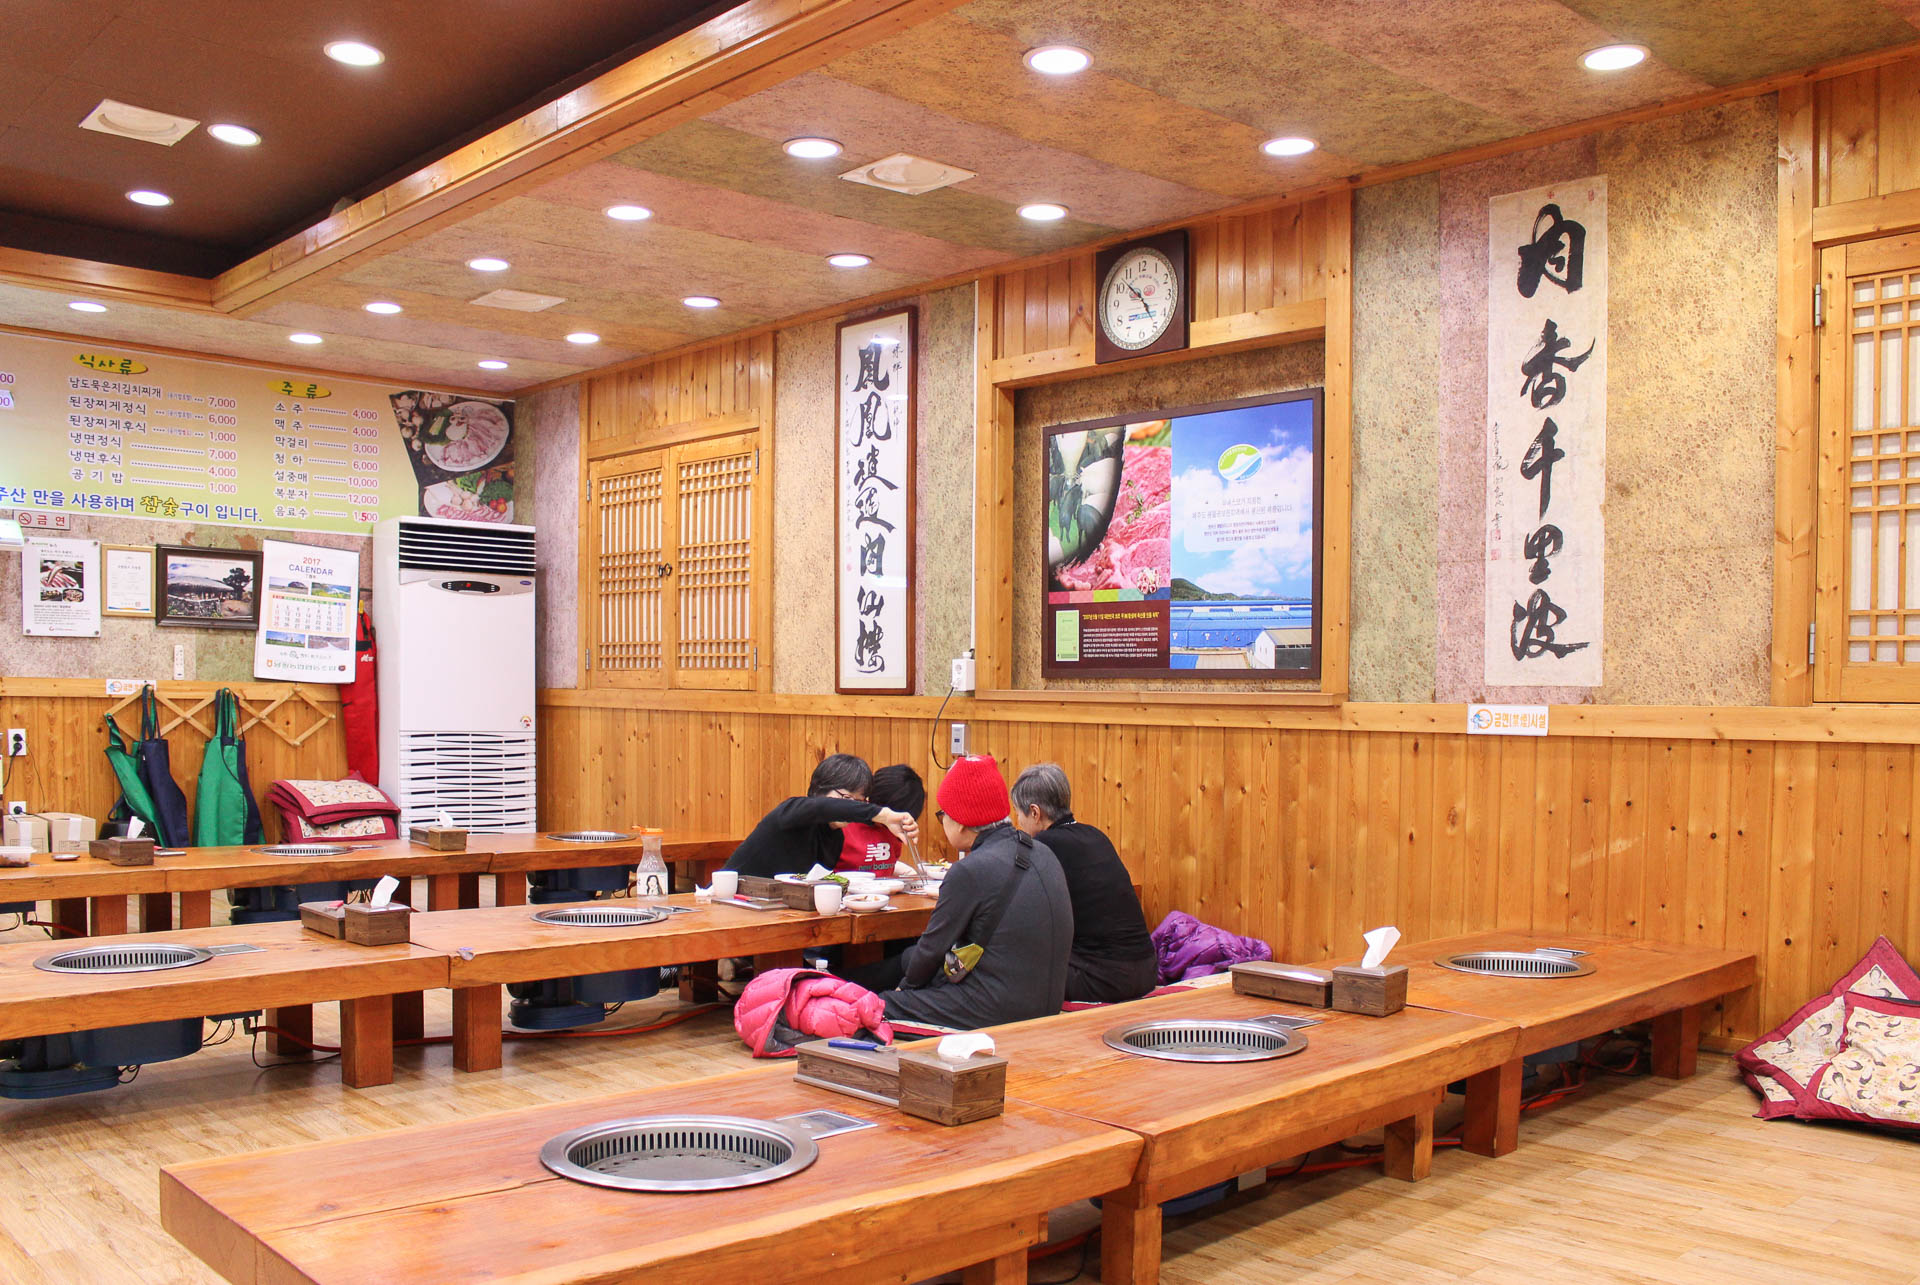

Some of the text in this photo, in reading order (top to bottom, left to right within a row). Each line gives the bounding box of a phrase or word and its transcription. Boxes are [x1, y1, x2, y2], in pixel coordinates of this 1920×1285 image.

[1138, 260, 1147, 273] 12
[1125, 267, 1132, 280] 11
[1115, 282, 1125, 294] 10
[79, 353, 132, 376] 식사류
[69, 377, 162, 399] 남도묵은지김치찌개
[208, 396, 236, 409] 7,000
[208, 414, 236, 426] 6,000
[352, 409, 378, 420] 4,000
[209, 431, 236, 443] 1,000
[352, 427, 378, 438] 4,000
[70, 431, 237, 461] 냉면정식 7,000
[275, 436, 378, 454] 막걸리 3,000
[70, 449, 237, 478] 냉면후식 4,000
[353, 460, 378, 471] 6,000
[274, 470, 378, 488] 설중매 10,000
[209, 482, 237, 494] 1,000
[33, 489, 65, 506] 만을
[71, 493, 134, 512] 사용하며
[274, 488, 378, 505] 복분자 12,000
[275, 505, 308, 518] 음료수
[303, 556, 321, 566] 2017
[288, 563, 334, 577] CALENDAR
